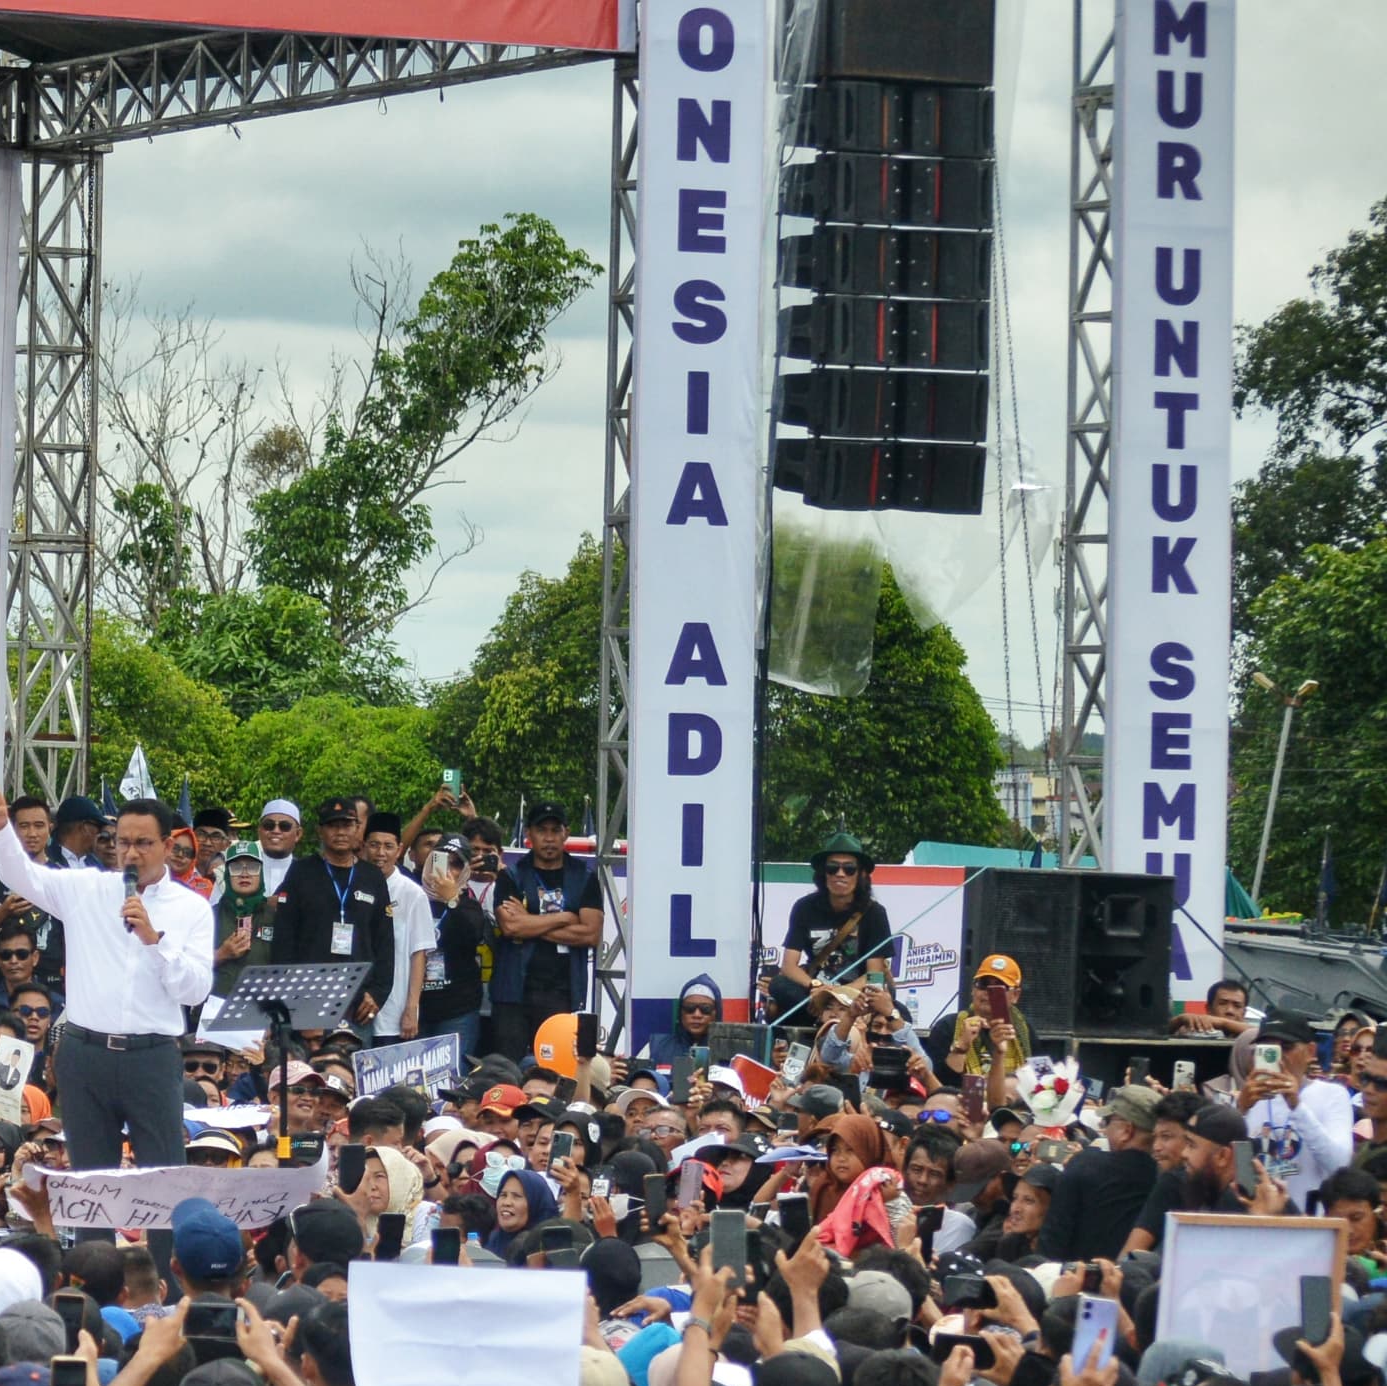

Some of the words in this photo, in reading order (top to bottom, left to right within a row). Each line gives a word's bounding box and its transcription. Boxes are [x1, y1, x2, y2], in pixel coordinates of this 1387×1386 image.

[1152, 246, 1201, 595] UNTUK
[665, 622, 729, 958] ADIL
[907, 946, 932, 958] ANIES
[907, 952, 953, 966] MUHAIMIN
